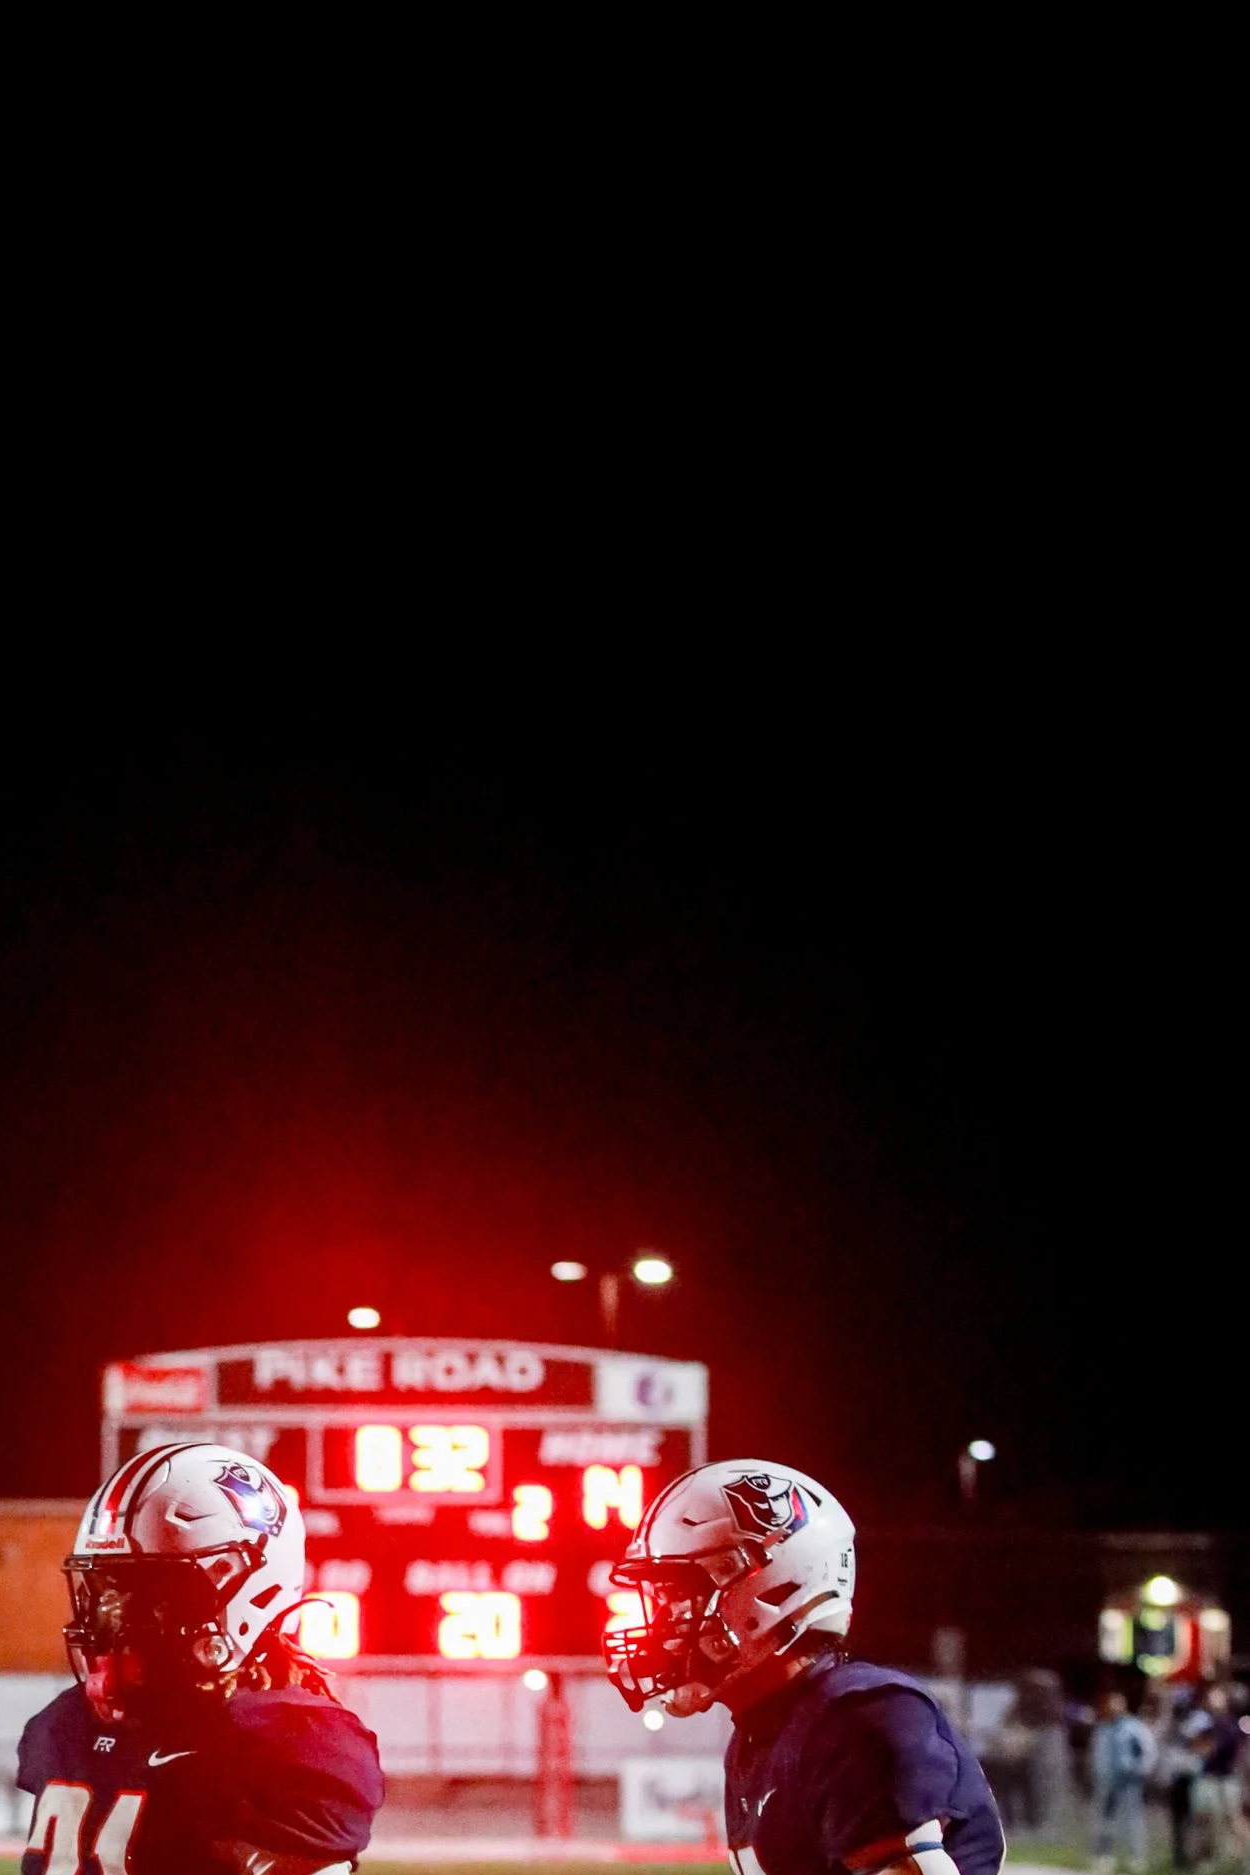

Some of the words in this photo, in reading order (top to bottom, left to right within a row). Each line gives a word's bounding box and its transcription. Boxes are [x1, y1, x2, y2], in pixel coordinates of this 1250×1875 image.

[254, 1350, 383, 1391] PIKE
[391, 1350, 546, 1392] ROAD
[511, 1484, 553, 1541] 2
[438, 1591, 521, 1659] 20
